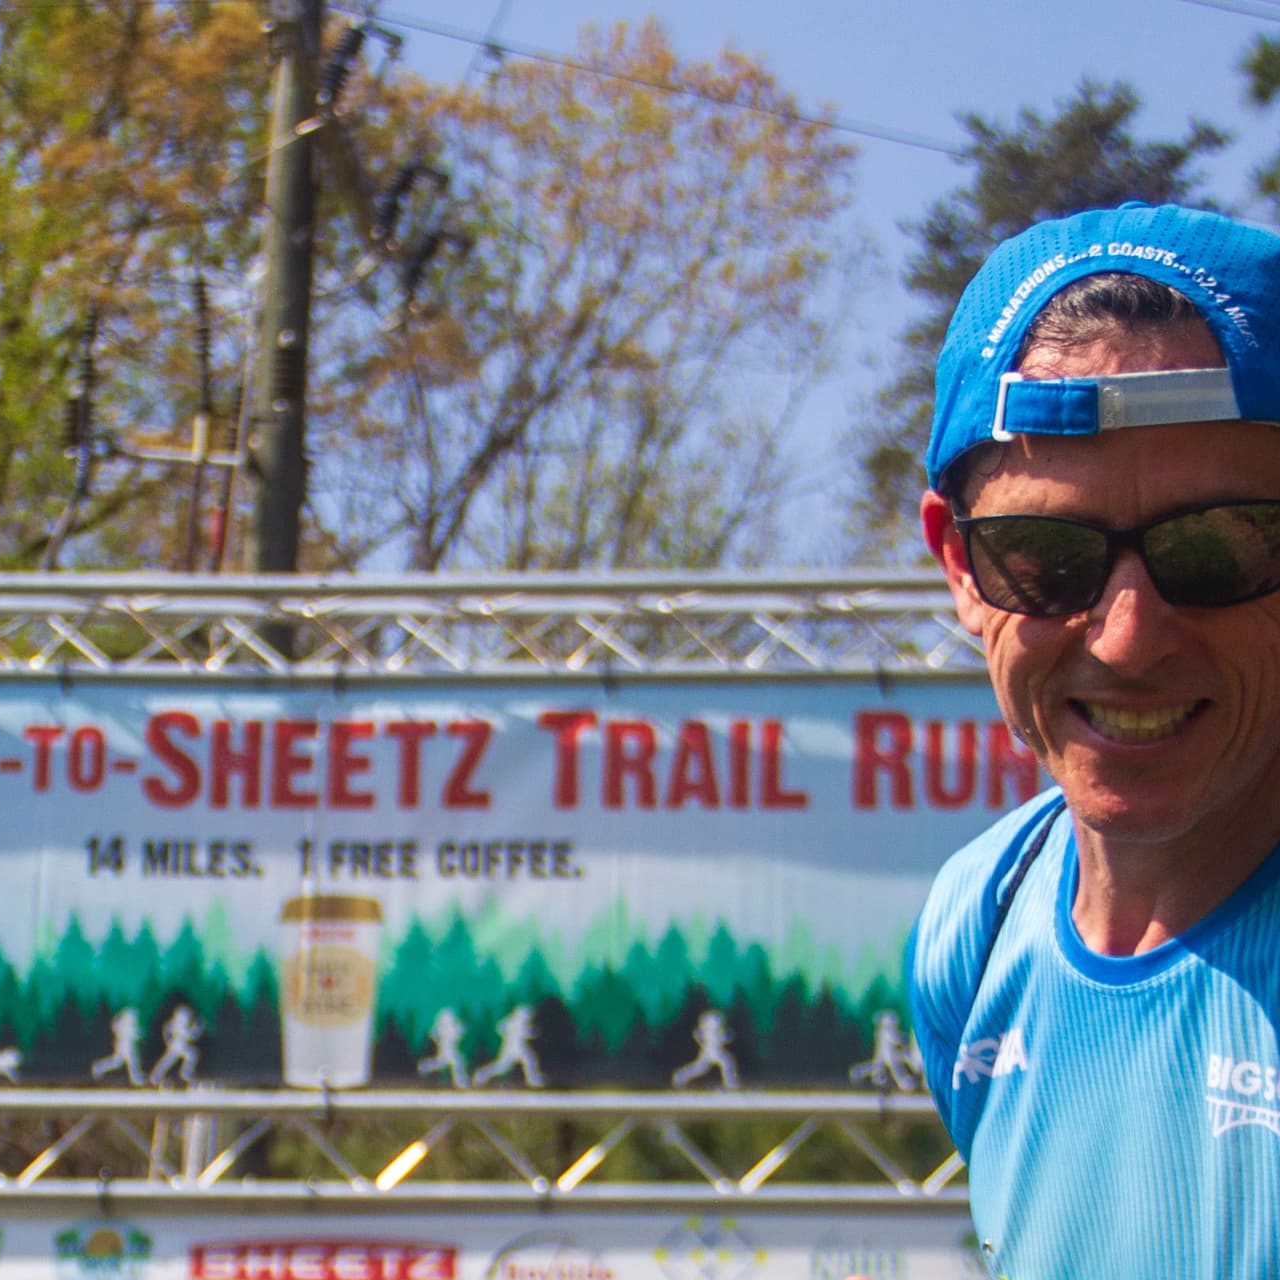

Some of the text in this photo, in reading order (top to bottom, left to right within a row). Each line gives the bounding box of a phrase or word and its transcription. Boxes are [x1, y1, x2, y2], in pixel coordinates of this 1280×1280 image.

[540, 708, 809, 812] TRAIL
[851, 710, 1041, 811] RUN
[85, 836, 125, 878] 14
[141, 837, 266, 879] MILES.
[329, 839, 420, 879] FREE
[437, 840, 586, 879] COFFEE.
